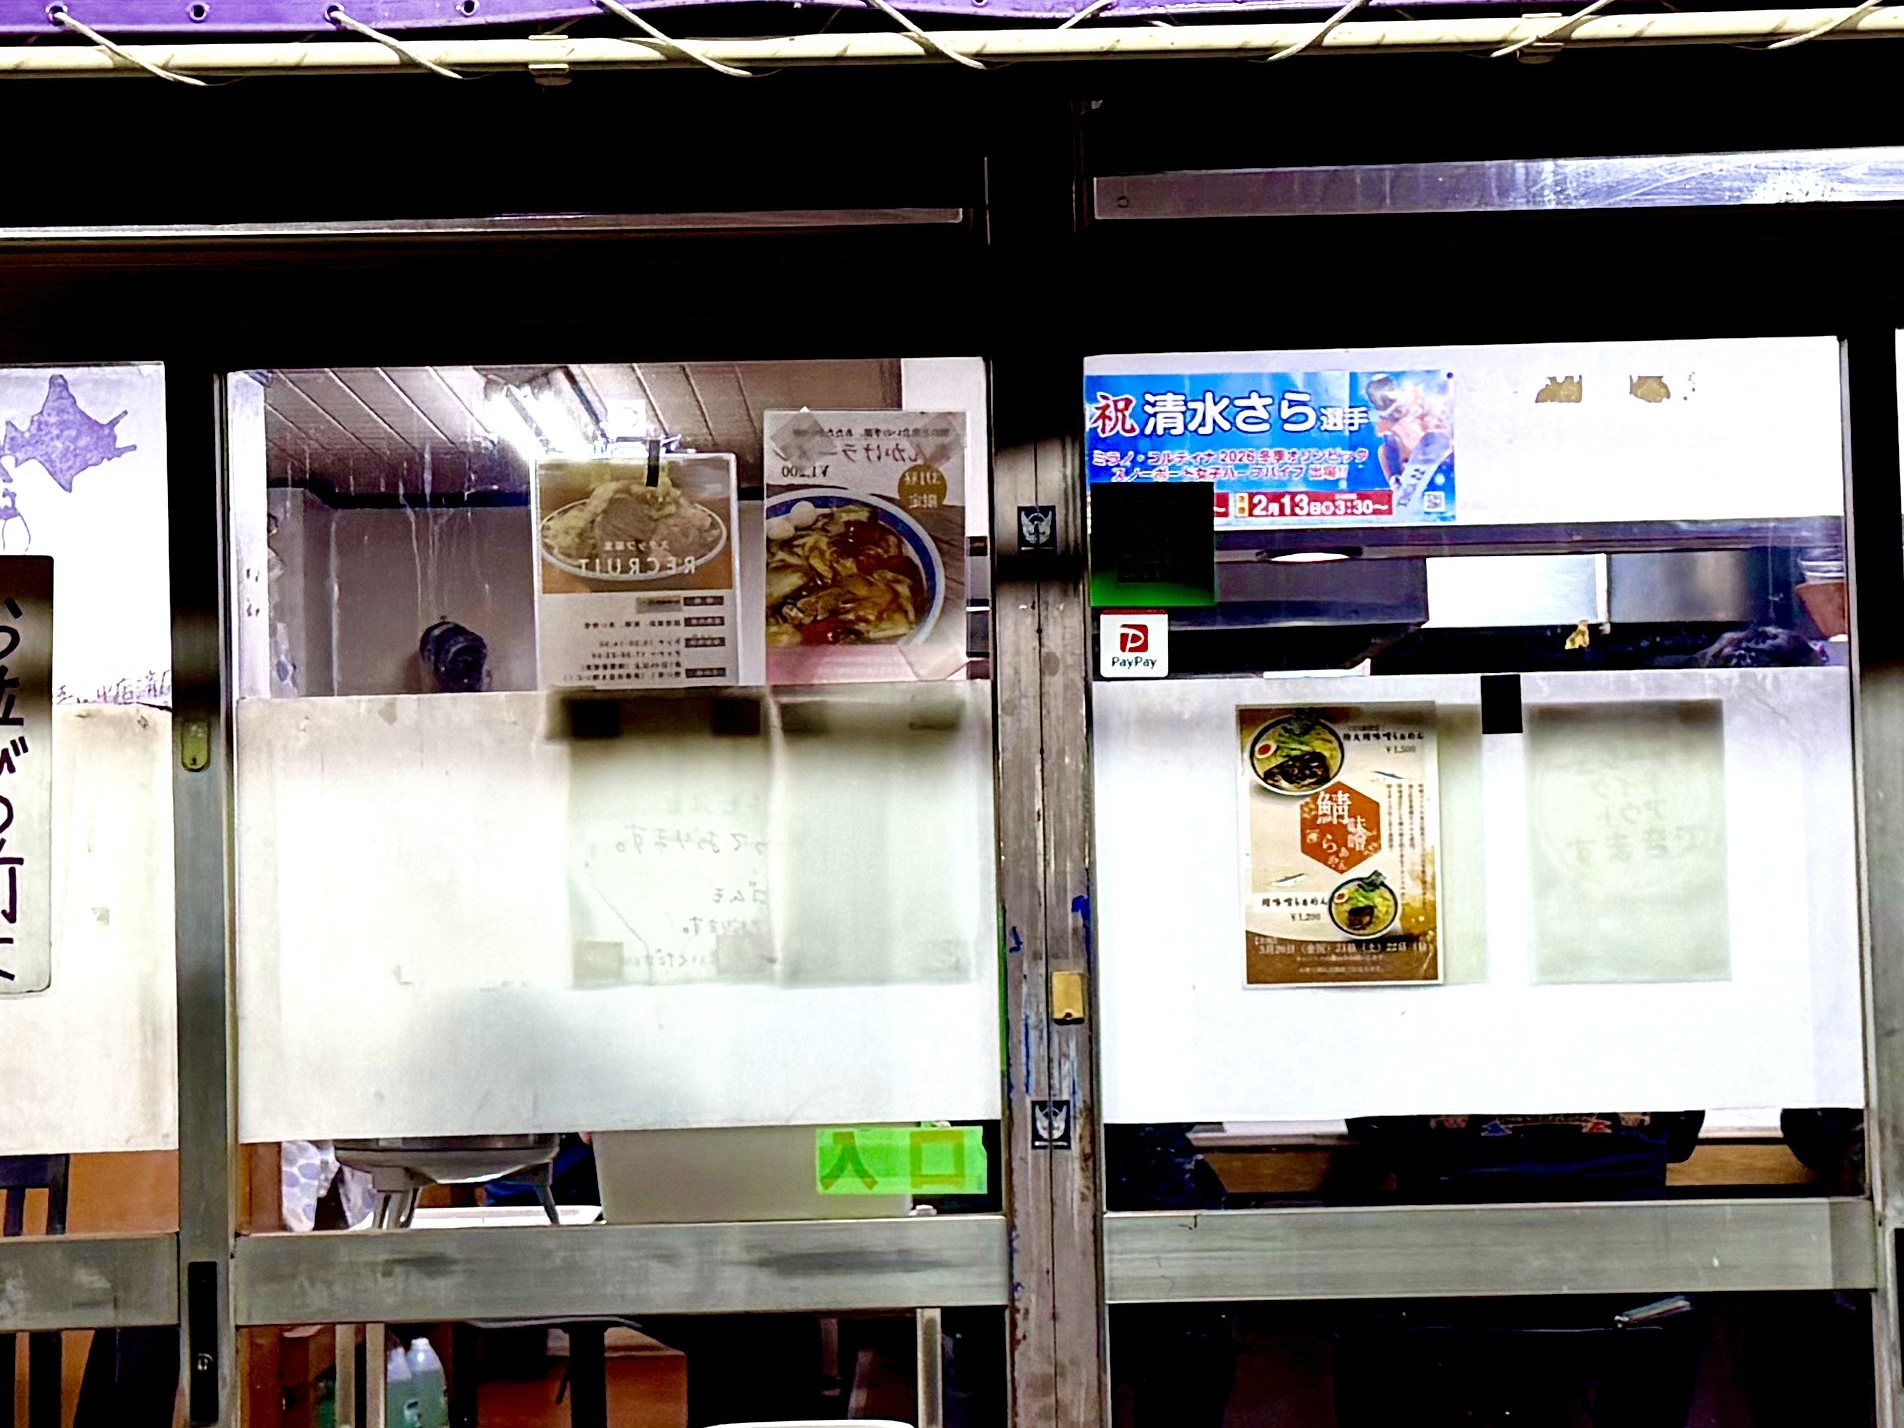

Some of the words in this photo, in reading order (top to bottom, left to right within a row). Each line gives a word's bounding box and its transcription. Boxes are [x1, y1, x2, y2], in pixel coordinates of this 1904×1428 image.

[1090, 395, 1138, 437] 祝
[1220, 450, 1255, 462] 2026
[1112, 656, 1157, 670] PayPay
[820, 1130, 965, 1190] 入口
